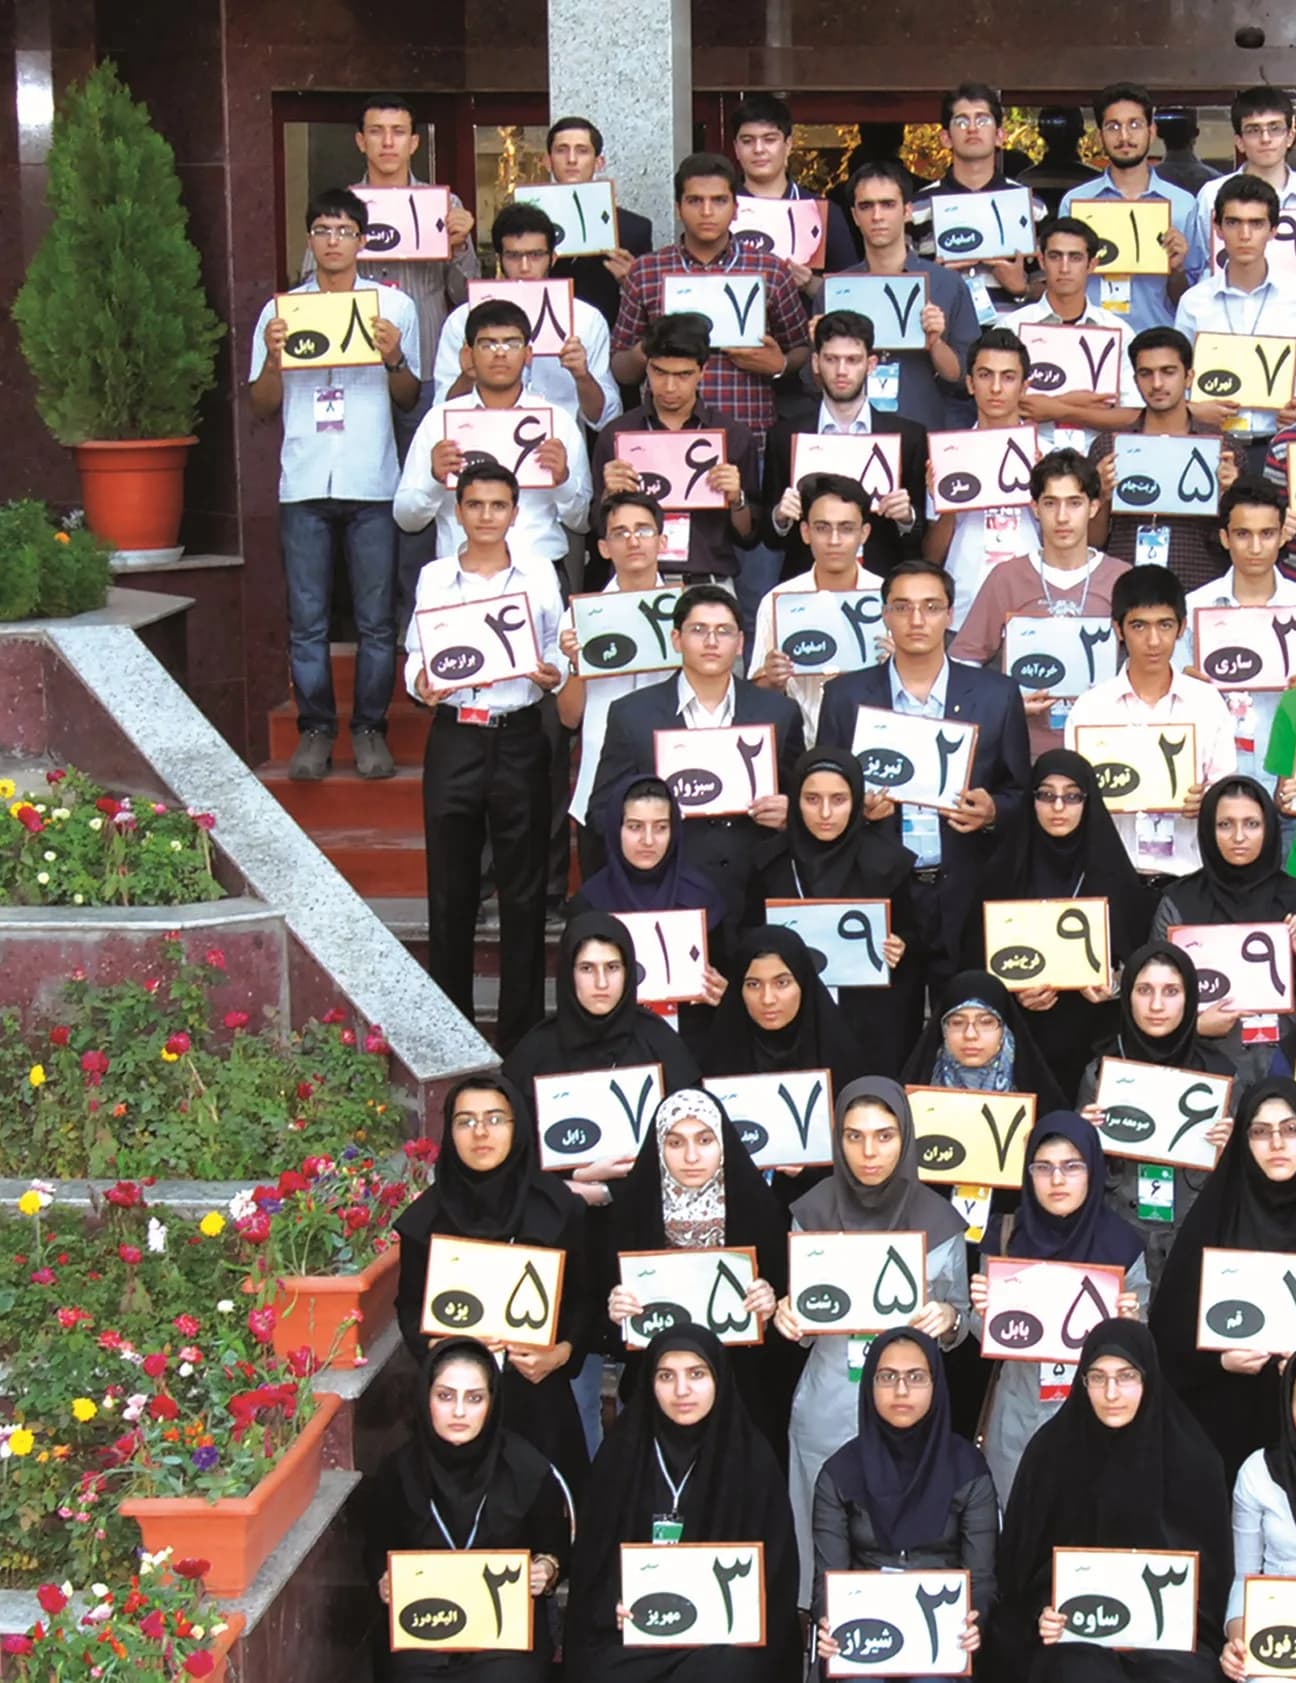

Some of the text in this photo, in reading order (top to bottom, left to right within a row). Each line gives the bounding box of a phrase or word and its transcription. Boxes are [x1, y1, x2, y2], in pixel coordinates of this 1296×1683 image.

[409, 195, 444, 250] ۱۰
[573, 191, 609, 242] ۱۰
[788, 208, 819, 256] ۱۰
[945, 233, 975, 247] اصفهان
[991, 200, 1027, 245] ۱۰
[340, 298, 376, 353] ۸
[532, 288, 566, 343] ۸
[724, 283, 760, 336] ۷
[884, 283, 920, 337] ۷
[294, 339, 314, 354] بابل
[1079, 336, 1115, 391] ۷
[1255, 344, 1291, 396] ۷
[1029, 369, 1060, 381] برازجا
[1205, 377, 1232, 389] تهران
[514, 416, 546, 474] ۶
[685, 439, 719, 500] ۶
[860, 443, 893, 498] ۵
[998, 438, 1031, 492] ۵
[1178, 448, 1214, 502] ۵
[484, 605, 526, 668] ۴
[603, 643, 617, 660] قم
[638, 594, 677, 660] ۴
[794, 641, 826, 655] اصفهان
[841, 596, 883, 663] ۴
[1080, 625, 1111, 683] ۳
[437, 655, 476, 672] برازجان
[1215, 658, 1252, 674] ساری
[674, 778, 714, 797] سبزوار
[737, 736, 763, 800] ۲
[864, 757, 903, 775] تبریز
[936, 730, 964, 796] ۲
[1096, 768, 1130, 788] تهران
[1159, 734, 1185, 798] ۲
[655, 922, 700, 984] ۱۰
[838, 910, 883, 972] ۹
[1057, 908, 1101, 973] ۹
[1241, 932, 1285, 996] ۹
[1199, 978, 1219, 993] اردب
[610, 1075, 653, 1144] ۷
[778, 1080, 822, 1149] ۷
[1122, 1117, 1150, 1131] صومعه
[1168, 1083, 1219, 1153] ۶
[562, 1129, 585, 1145] زابل
[924, 1146, 953, 1161] تهران
[981, 1104, 1026, 1172] ۷
[964, 1199, 977, 1215] ۷
[1151, 1180, 1162, 1197] ۶
[505, 1261, 549, 1329] ۵
[707, 1260, 751, 1334] ۵
[806, 1295, 839, 1313] رشت
[873, 1246, 917, 1315] ۵
[445, 1303, 468, 1320] یزد
[643, 1312, 674, 1331] دیلم
[1001, 1320, 1029, 1340] بابل
[1061, 1276, 1110, 1349] ۵
[1227, 1311, 1242, 1328] قم
[412, 1611, 457, 1627] الیگودرز
[483, 1564, 521, 1637] ۳
[646, 1610, 680, 1625] مهریز
[713, 1558, 752, 1633] ۳
[1073, 1609, 1119, 1626] ساوه
[1142, 1565, 1188, 1640] ۳
[843, 1633, 892, 1655] شیراز
[916, 1584, 962, 1663] ۳
